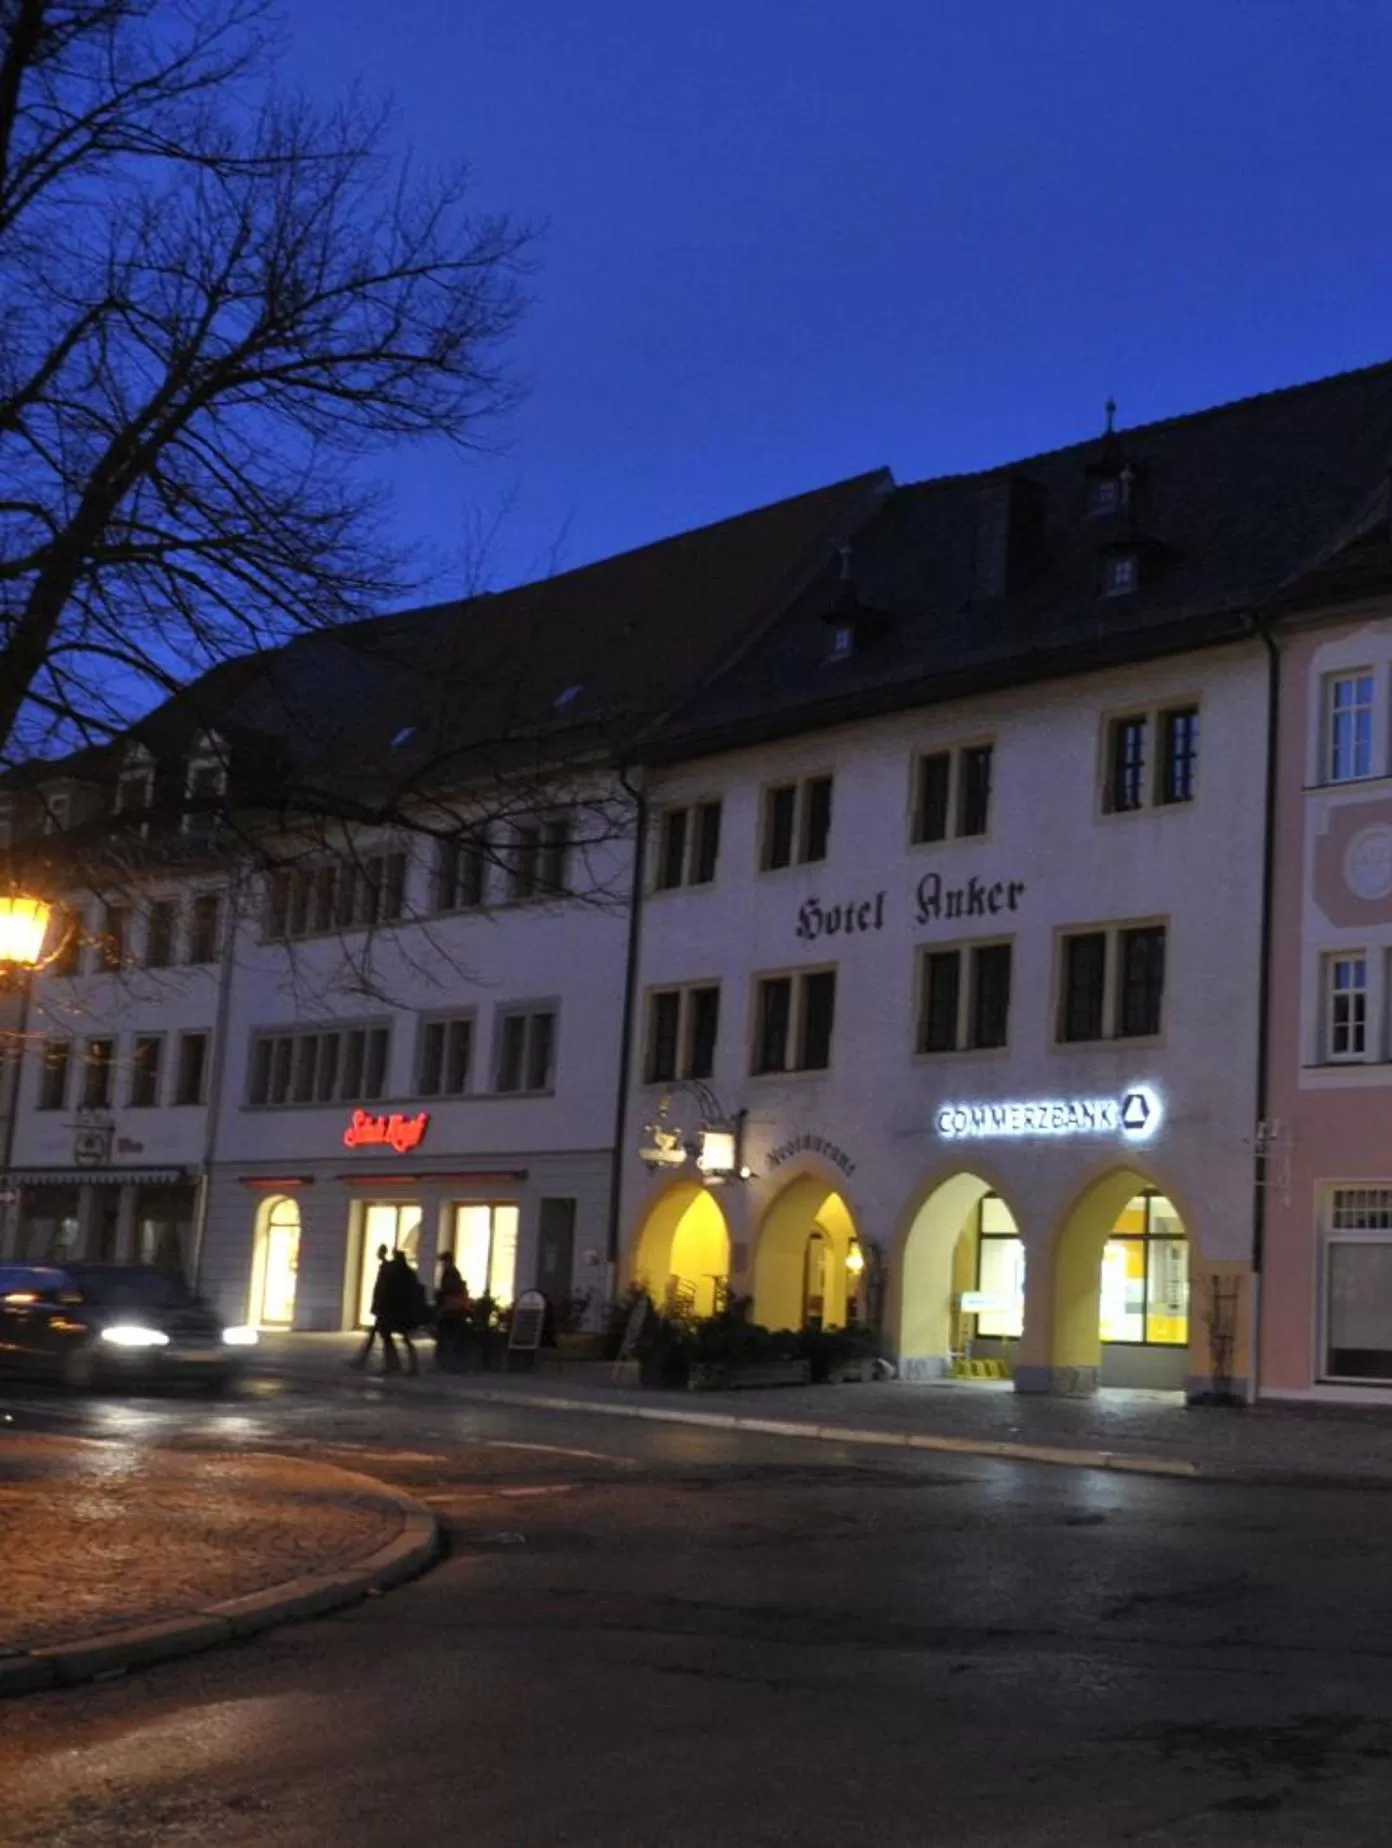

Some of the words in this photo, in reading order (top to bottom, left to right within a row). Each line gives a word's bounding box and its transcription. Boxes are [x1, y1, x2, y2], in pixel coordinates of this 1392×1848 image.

[796, 889, 889, 940] Hotel
[916, 872, 1026, 925] Anker
[937, 1100, 1120, 1133] COMMERZBANK
